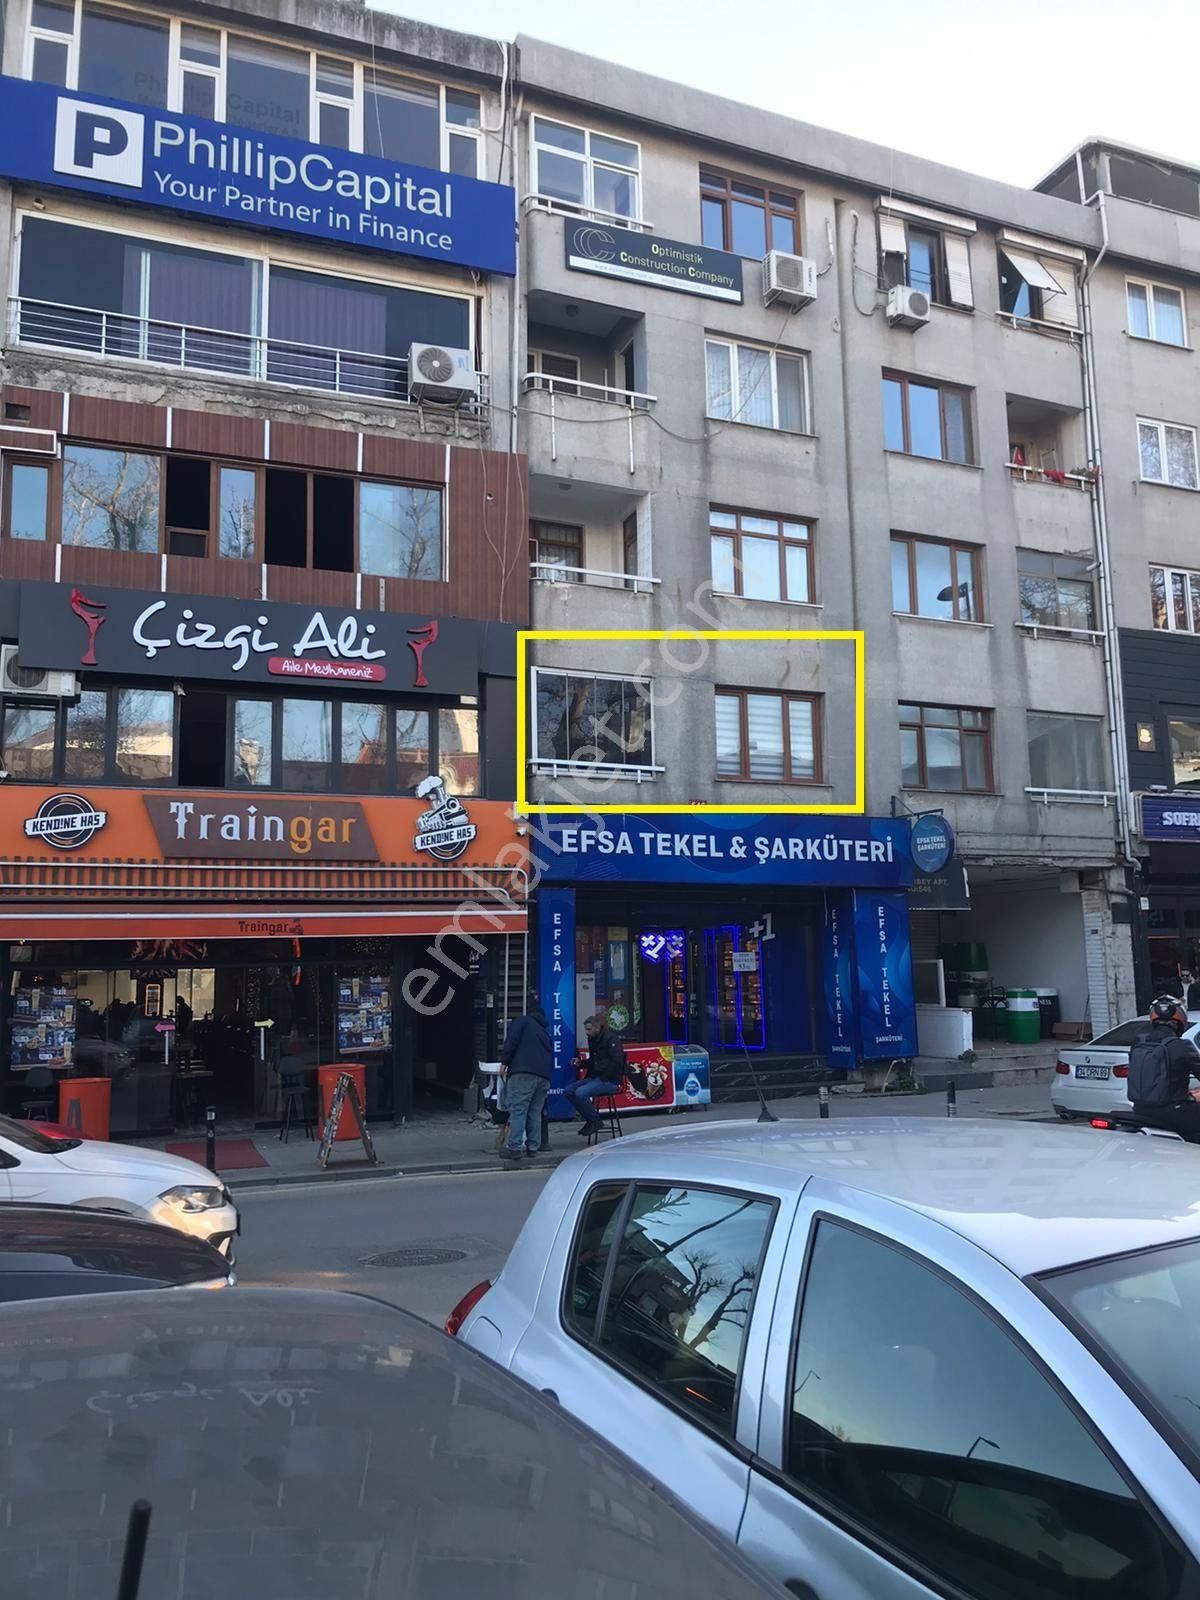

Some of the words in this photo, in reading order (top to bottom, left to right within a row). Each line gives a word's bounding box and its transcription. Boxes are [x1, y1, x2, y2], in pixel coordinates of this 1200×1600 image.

[73, 110, 129, 169] P
[153, 120, 452, 218] PhillipCapital
[154, 170, 217, 203] Your
[225, 186, 321, 224] Partner
[329, 206, 350, 230] in
[359, 213, 453, 250] Finance
[620, 251, 687, 275] Construction
[688, 267, 734, 287] Company
[651, 243, 704, 265] Optimistik
[132, 600, 279, 671] Çizgi
[292, 611, 386, 660] Ali
[282, 660, 303, 672] Aile
[304, 662, 373, 678] Meyhaneniz
[80, 814, 100, 827] HAS
[169, 801, 357, 854] Traingar
[456, 827, 472, 840] HAS
[930, 835, 946, 843] TEKEL
[1162, 811, 1200, 826] SOFR
[562, 829, 634, 854] EFSA
[639, 832, 723, 858] TEKEL
[729, 836, 747, 858] &
[754, 834, 894, 864] ŞARKÜTERİ
[238, 920, 289, 936] Traingar
[553, 913, 562, 972] EFSA
[831, 909, 839, 958] EFSA
[878, 906, 888, 953] EFSA
[835, 974, 843, 1037] TEKEL
[881, 967, 892, 1027] TEKEL
[553, 992, 562, 1069] TEKEL
[875, 1033, 903, 1044] ŞARKÜTERİ
